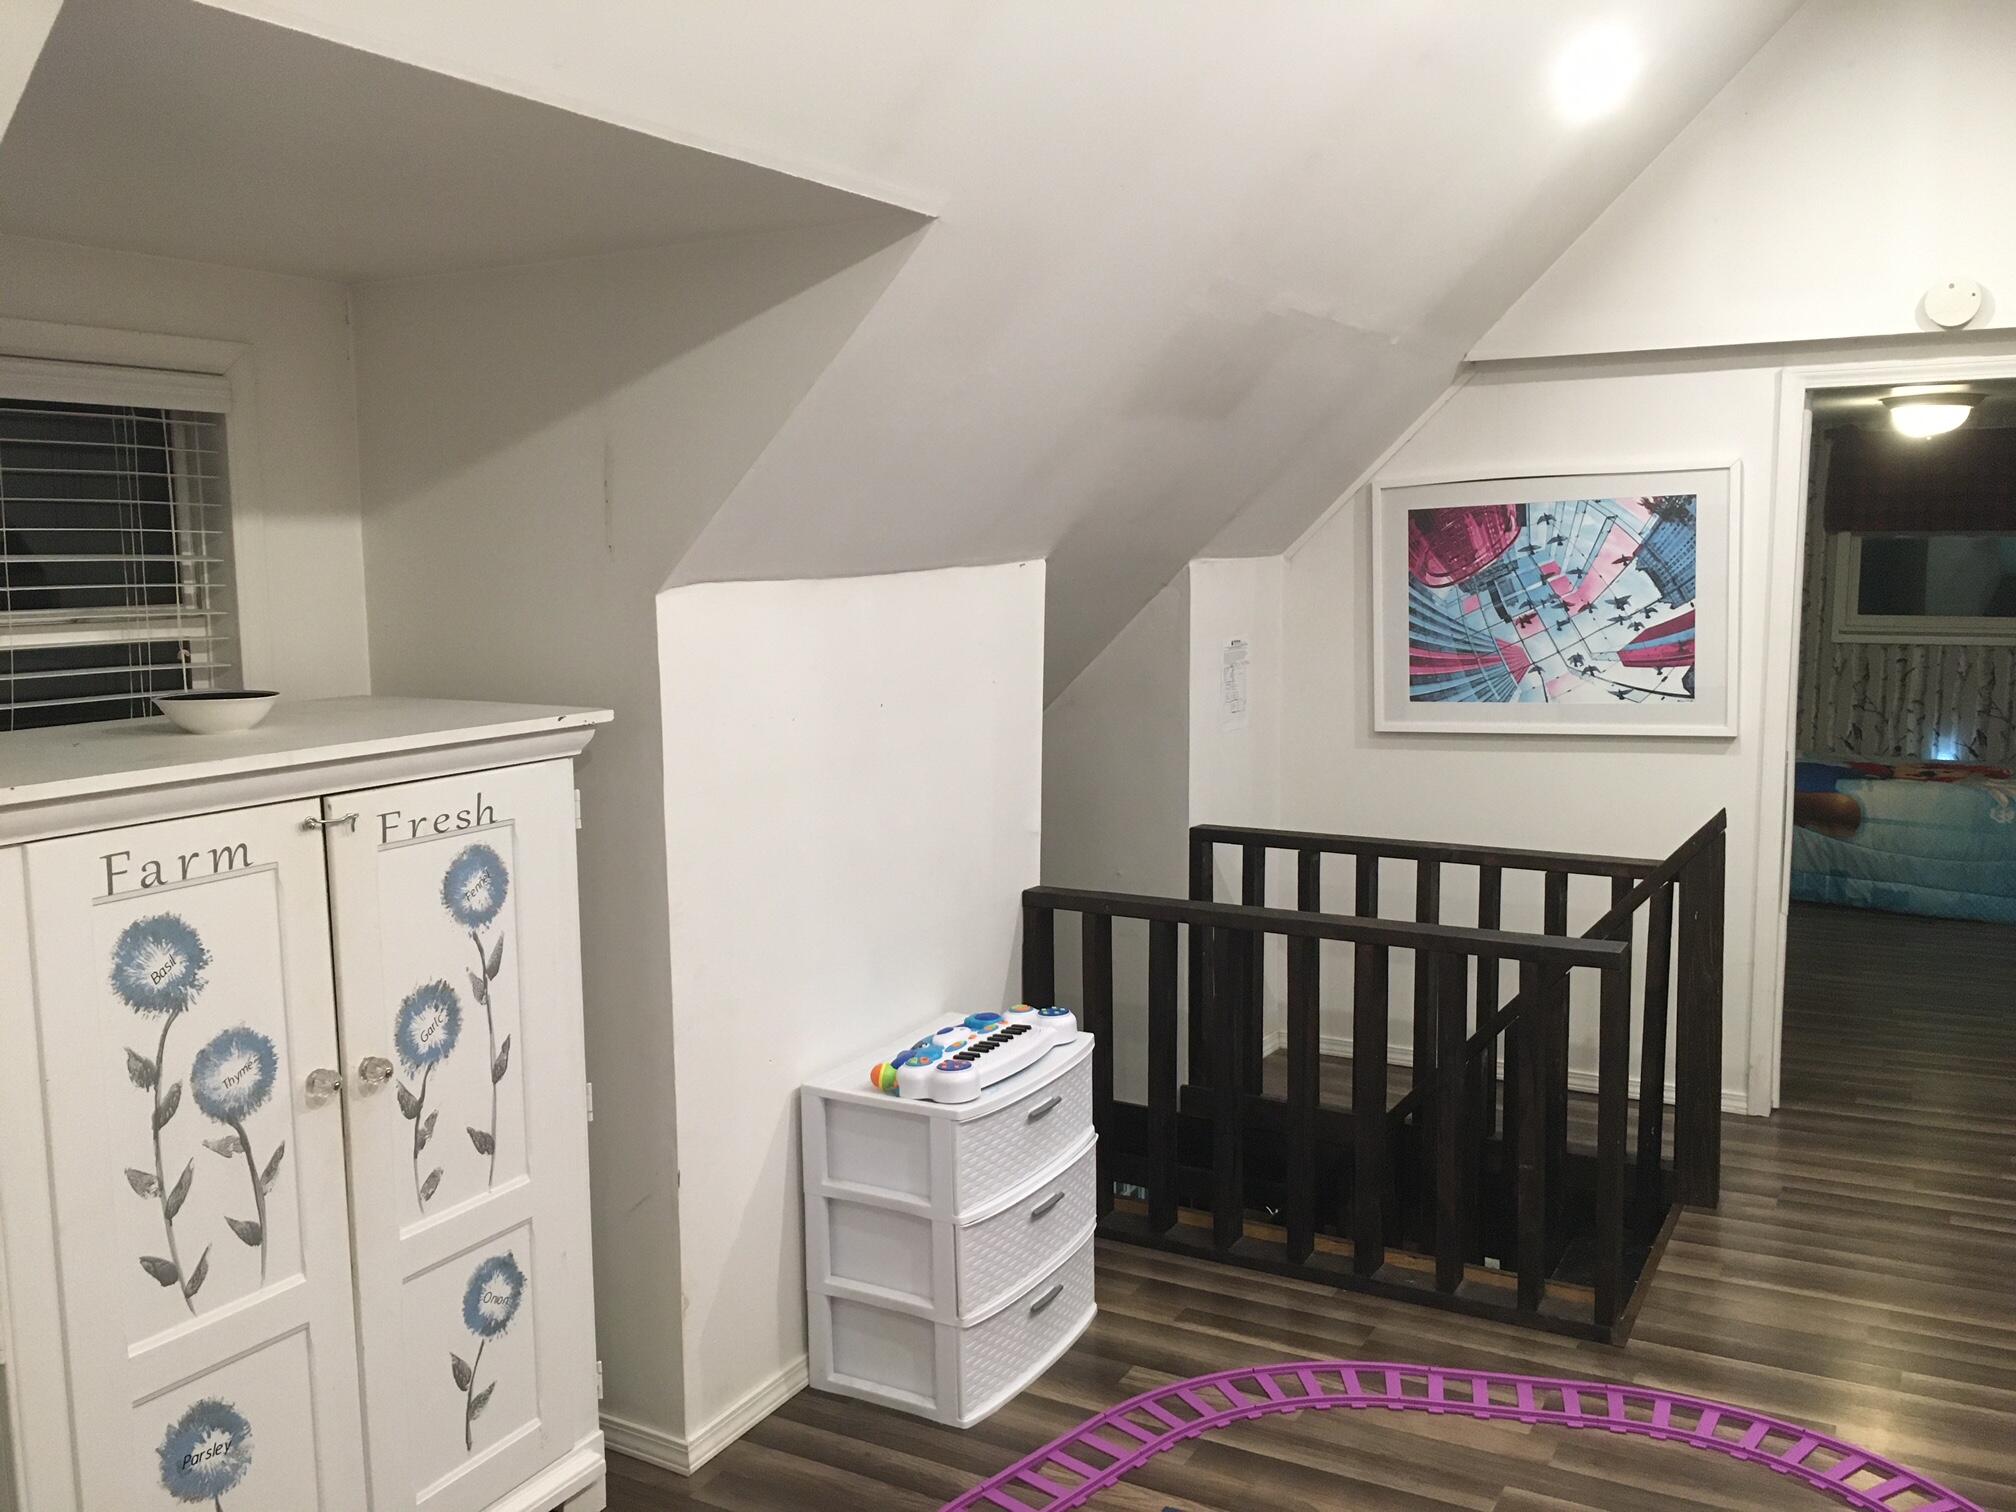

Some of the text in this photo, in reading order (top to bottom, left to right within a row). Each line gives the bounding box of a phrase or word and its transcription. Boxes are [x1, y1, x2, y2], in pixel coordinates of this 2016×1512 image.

[99, 792, 499, 896] Farm Fresh
[150, 953, 177, 985] Basil
[420, 1014, 444, 1043] Garlc
[222, 1060, 254, 1089] Thyme
[182, 1440, 232, 1470] Parsley
